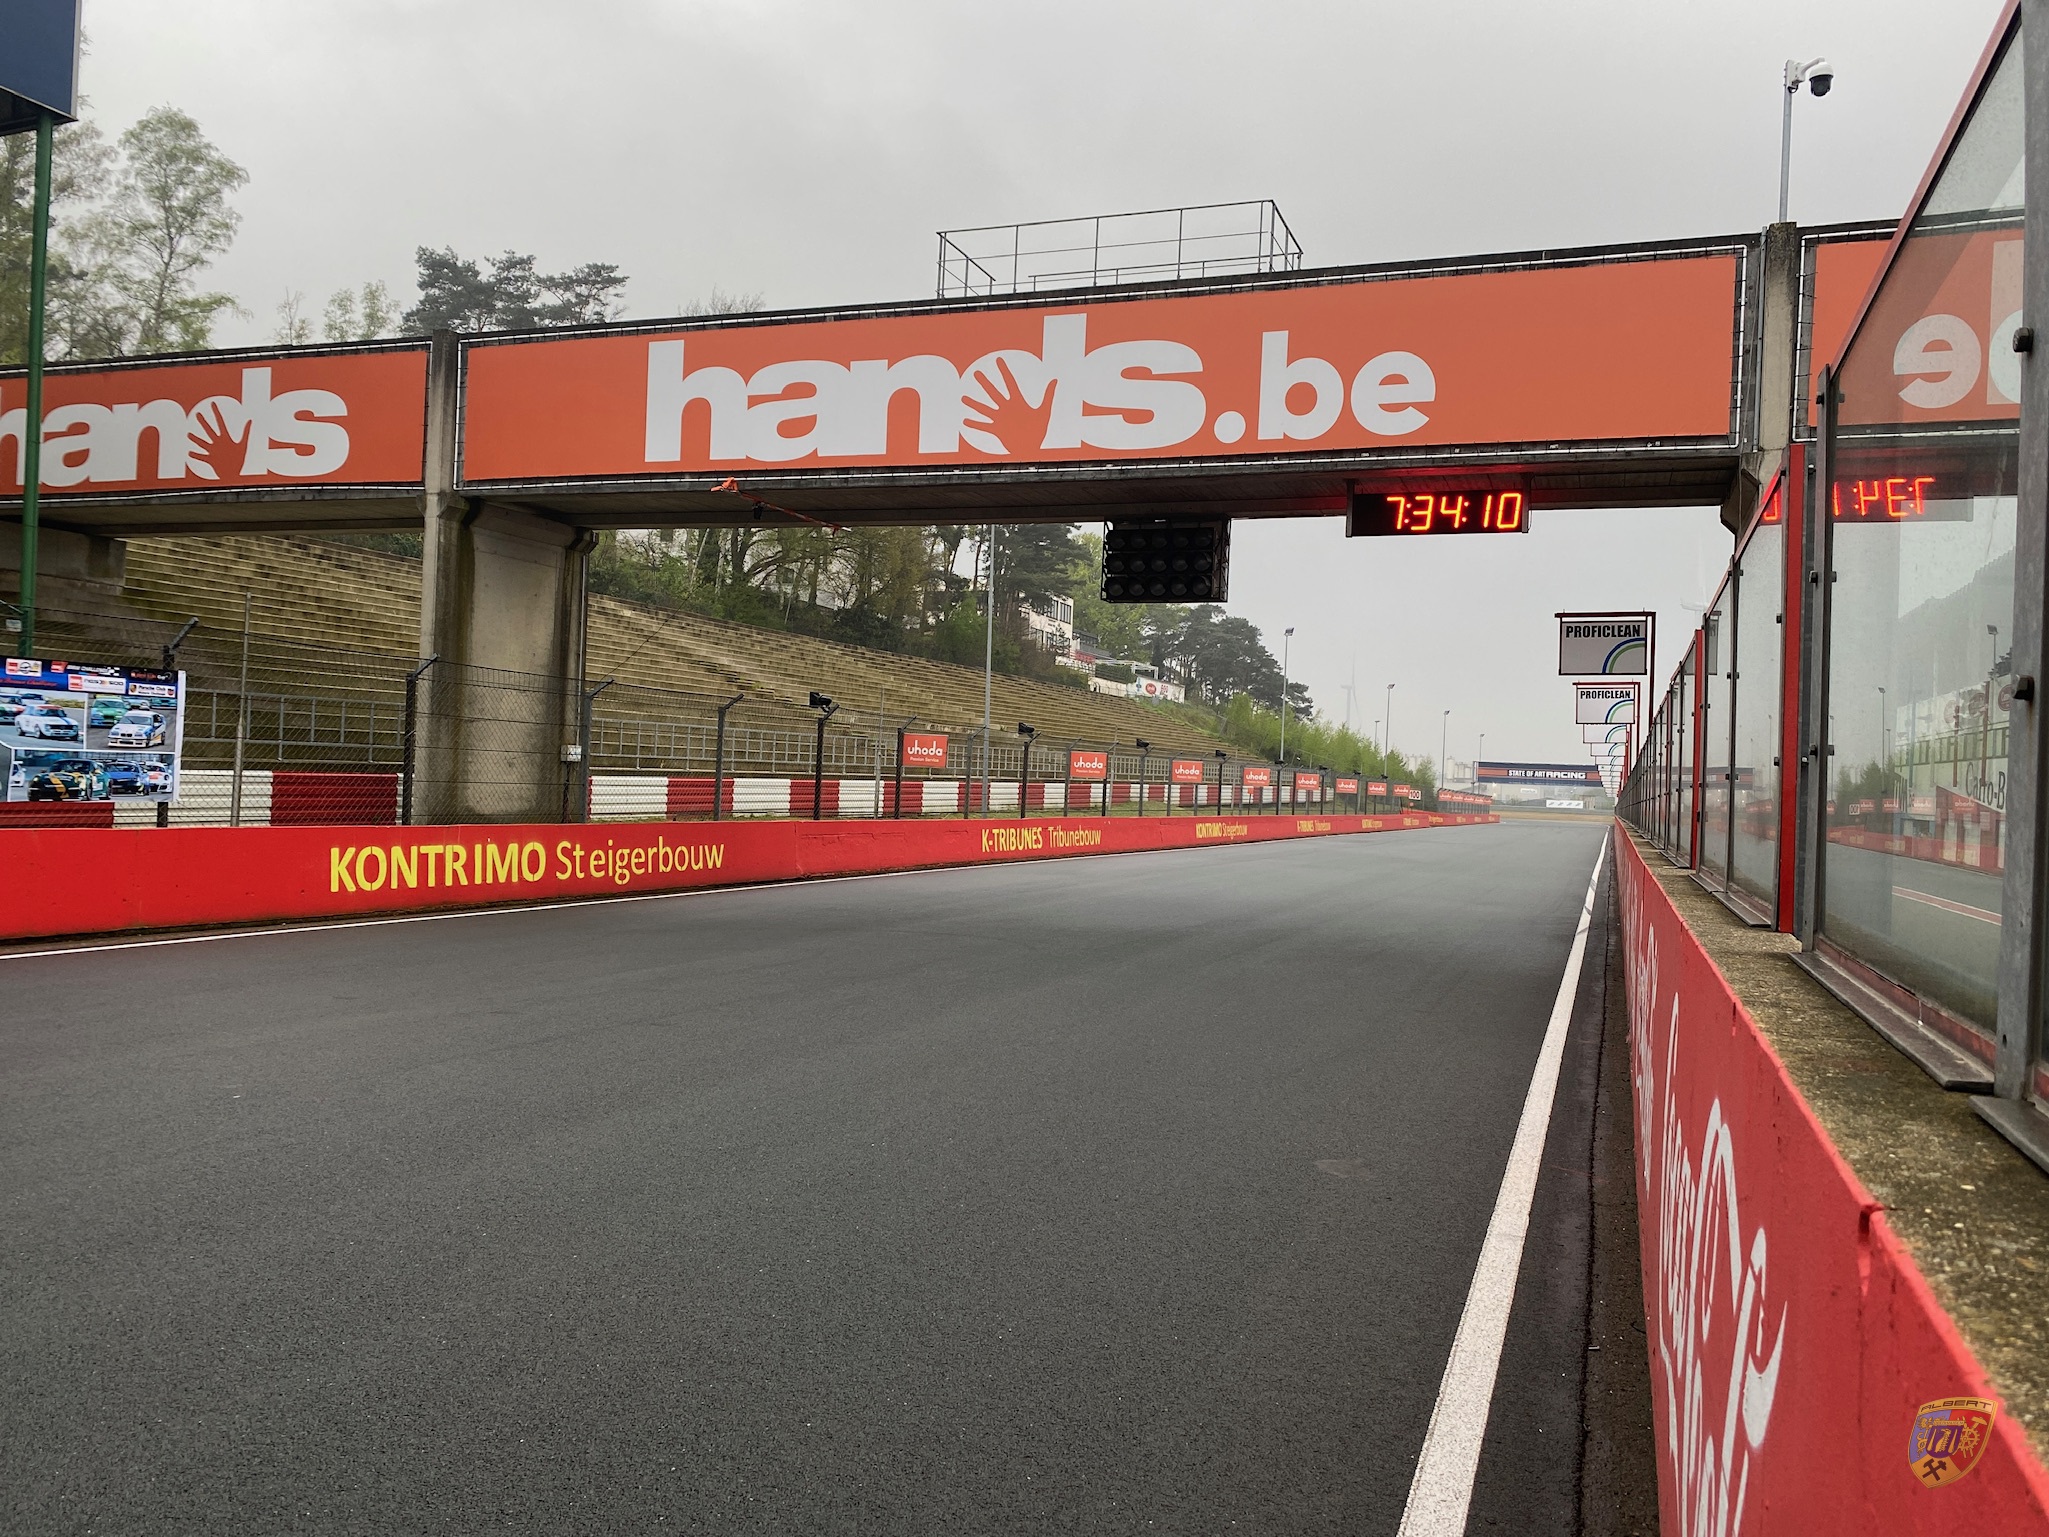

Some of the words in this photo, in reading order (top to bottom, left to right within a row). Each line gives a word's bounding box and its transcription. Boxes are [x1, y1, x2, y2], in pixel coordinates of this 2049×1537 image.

[645, 312, 1436, 462] hands.be
[1386, 492, 1522, 531] 7:34:10
[1565, 624, 1641, 638] PROFICLEAN
[1580, 690, 1631, 699] PROFICLEAN
[907, 740, 943, 757] uhoda
[1073, 756, 1104, 770] uhoda
[1175, 764, 1200, 775] uhoda
[1246, 771, 1268, 781] uhoda
[1508, 769, 1525, 777] STATE
[1525, 769, 1535, 777] OF
[1534, 770, 1546, 778] ART
[1545, 771, 1587, 779] RACING
[1409, 790, 1420, 799] 100
[981, 826, 1043, 853] K-TRIBUNES
[1048, 825, 1102, 848] Tribunebouw
[329, 842, 547, 893] KONTRIMO
[555, 835, 726, 886] Steigerbouw
